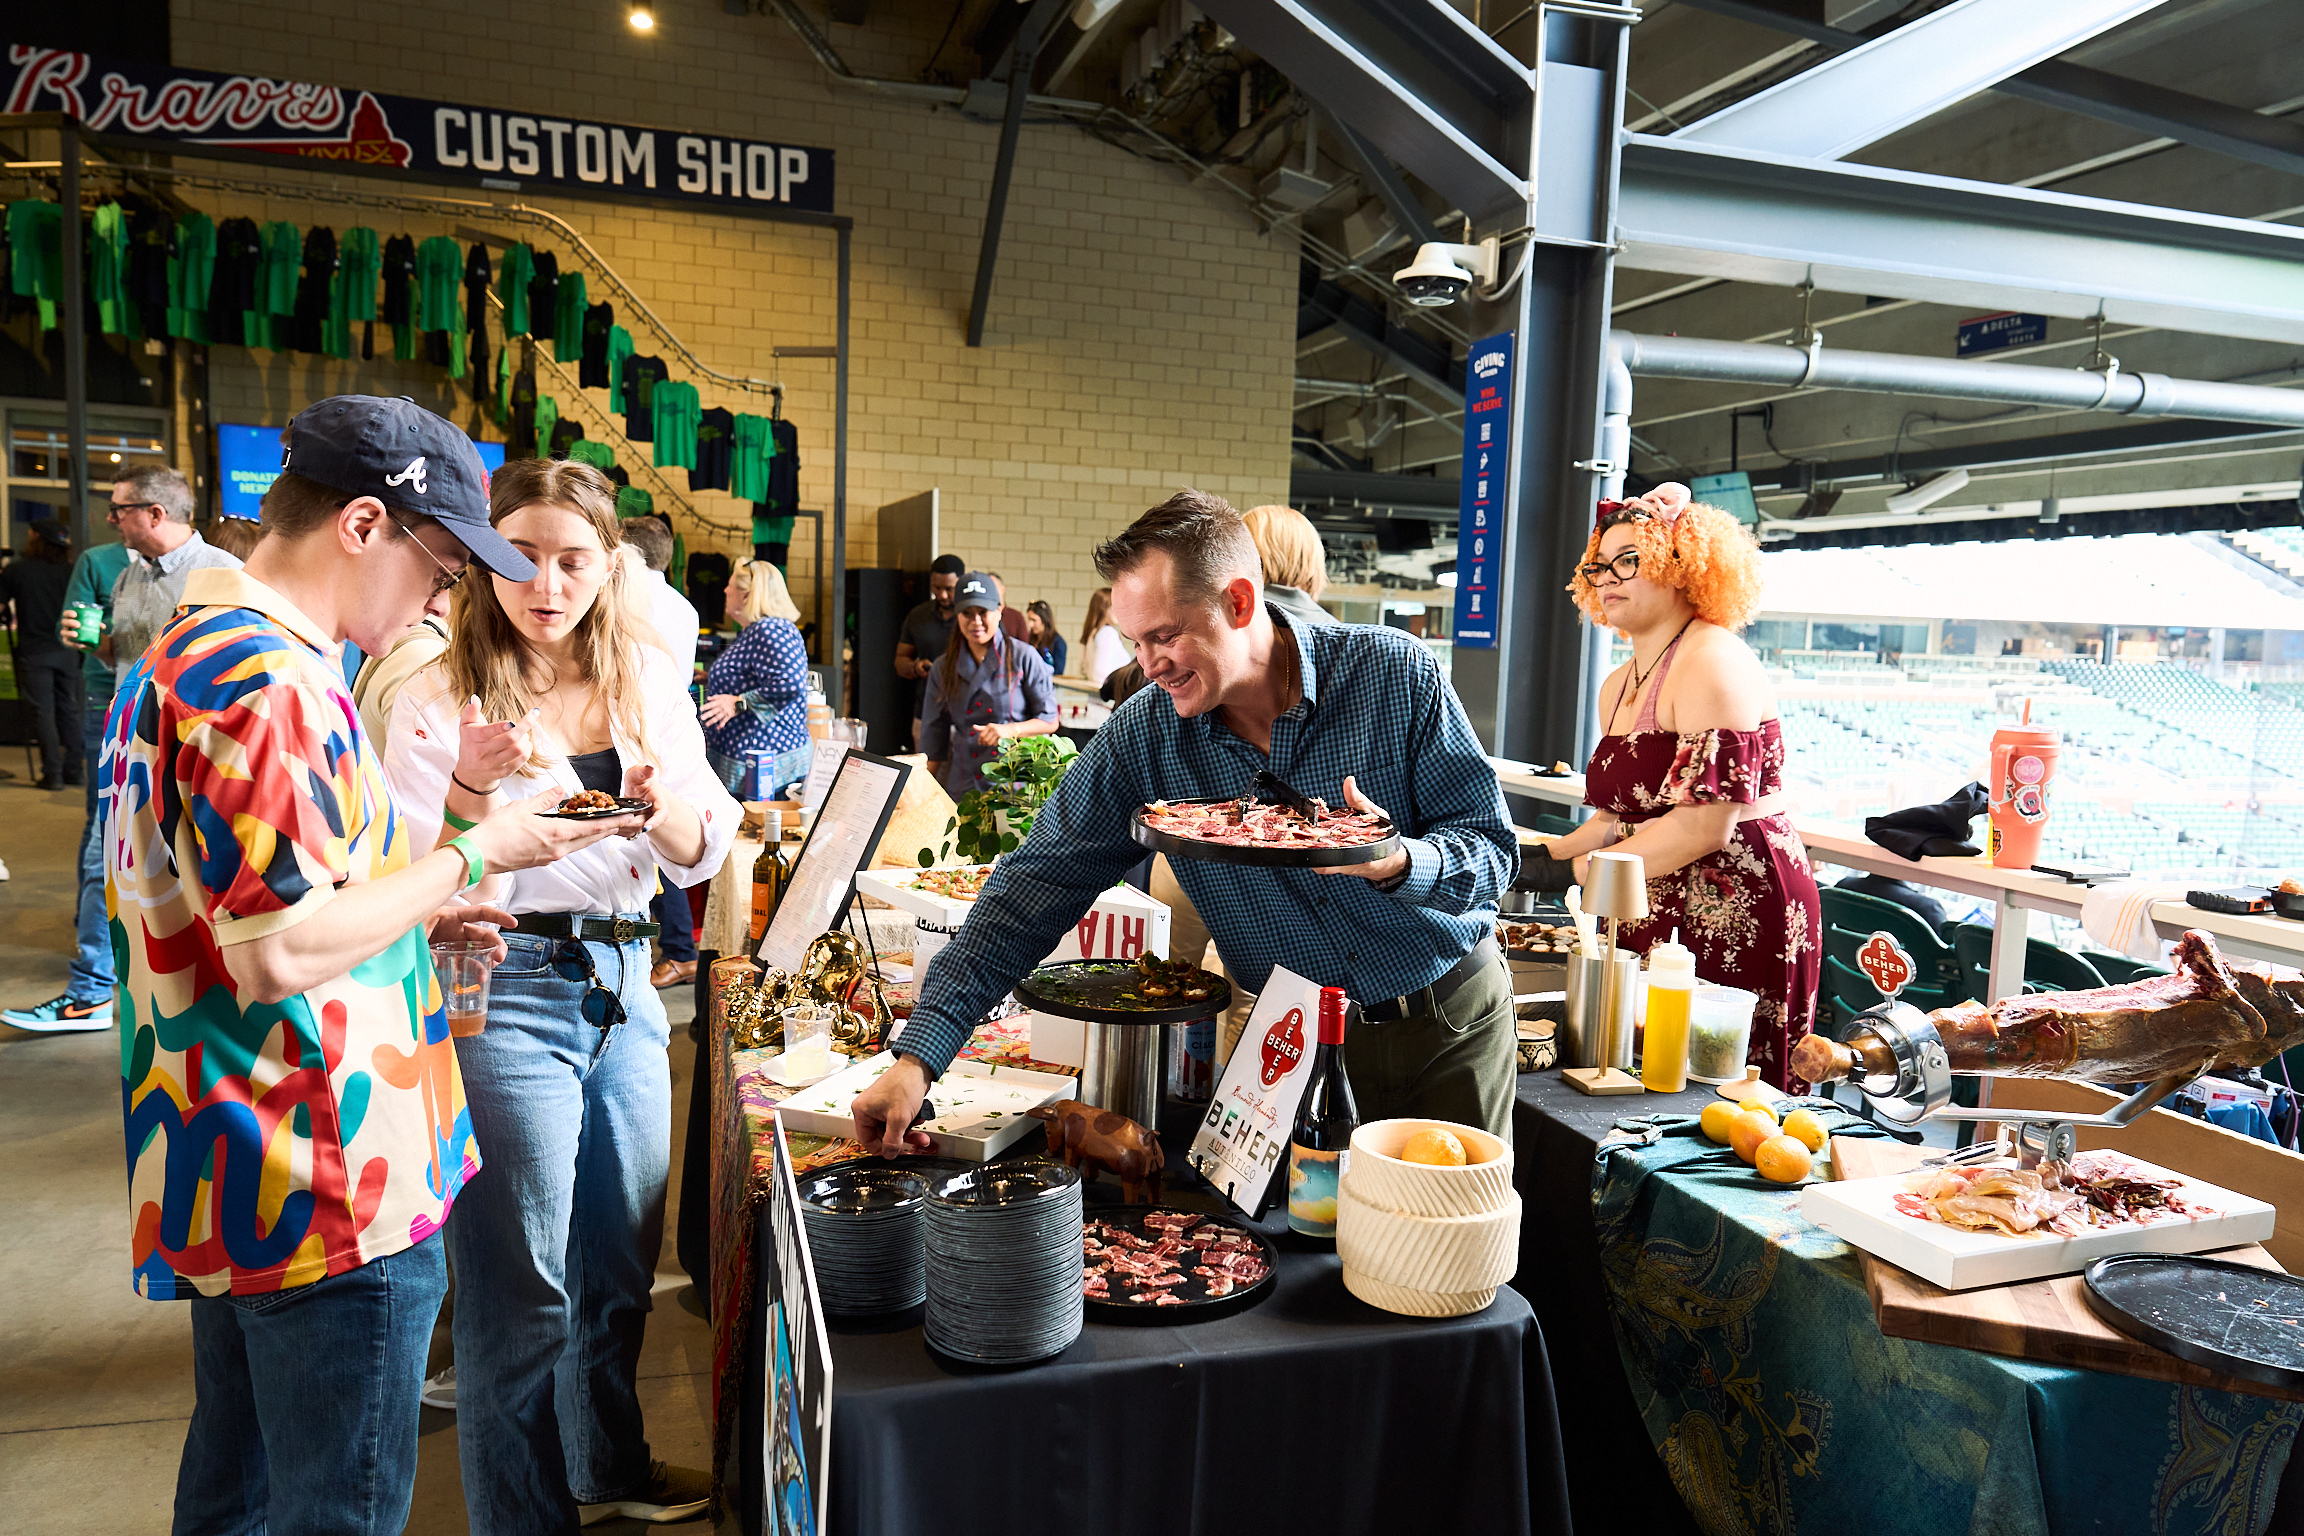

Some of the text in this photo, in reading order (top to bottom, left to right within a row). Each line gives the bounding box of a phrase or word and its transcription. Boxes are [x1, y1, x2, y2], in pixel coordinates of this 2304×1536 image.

[3, 44, 345, 132] Braves
[434, 107, 809, 202] CUSTOM SHOP
[1990, 316, 2022, 332] DELTA
[1474, 352, 1505, 374] GIVING
[1483, 397, 1502, 411] SERVE
[386, 456, 437, 494] A
[752, 908, 768, 917] DAL
[1864, 955, 1905, 975] BEHER
[1878, 941, 1890, 989] BEHER
[1267, 1033, 1301, 1061] BEHER
[1206, 1100, 1280, 1173] BEHER
[1208, 1138, 1257, 1180] AUTÉNTICO
